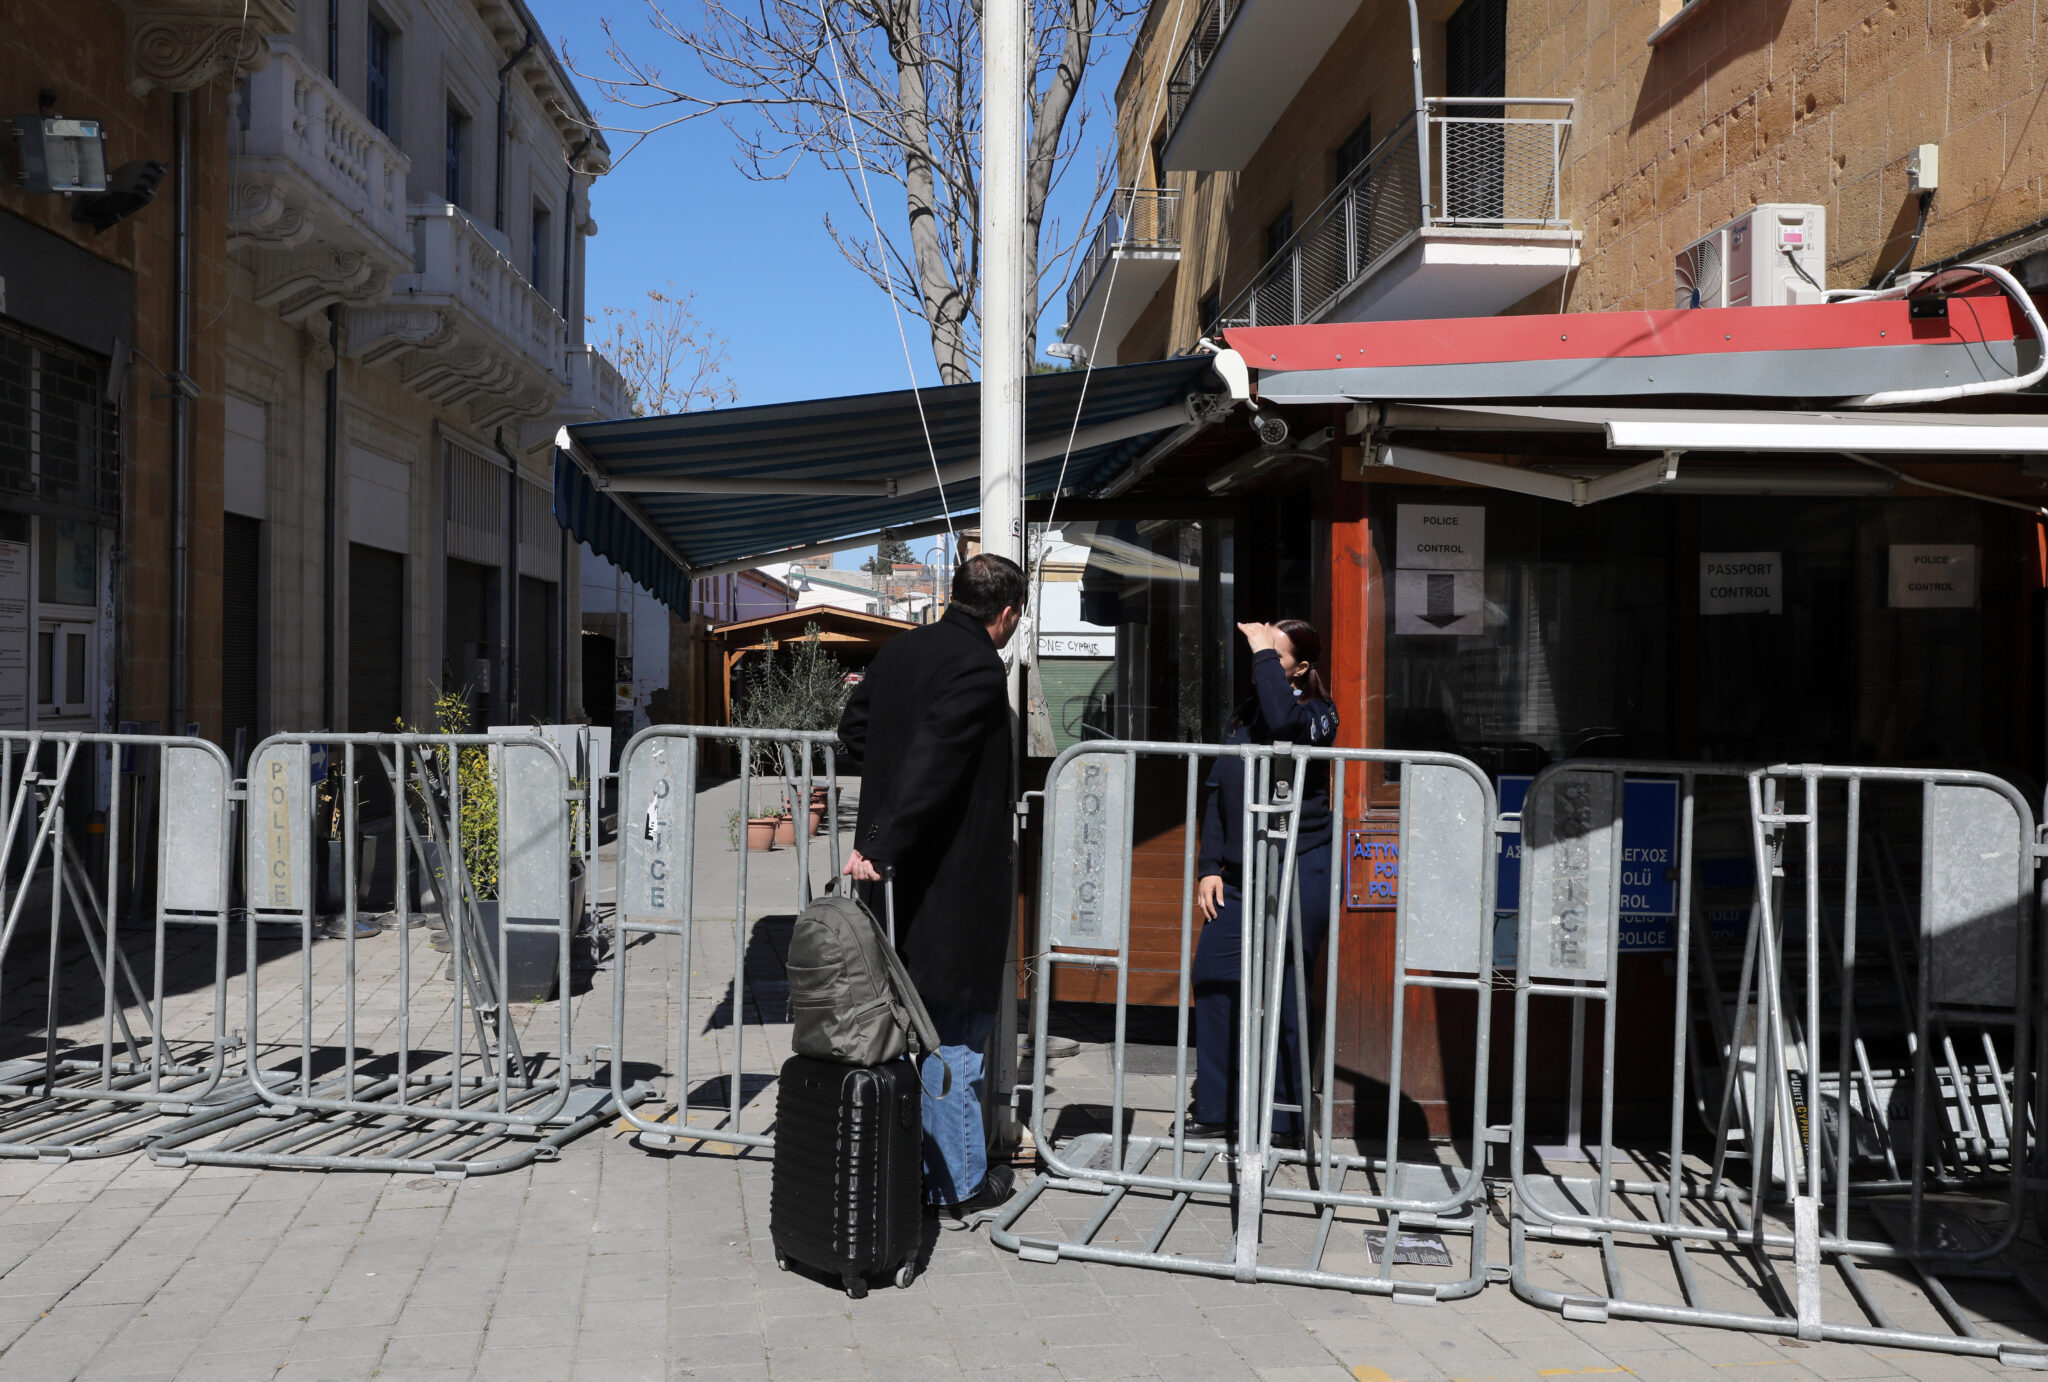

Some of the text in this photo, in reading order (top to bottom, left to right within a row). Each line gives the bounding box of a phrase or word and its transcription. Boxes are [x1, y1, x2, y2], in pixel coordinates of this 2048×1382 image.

[1423, 516, 1459, 525] POLICE
[1417, 544, 1464, 553] CONTROL
[1914, 555, 1949, 565] POLICE
[1708, 563, 1773, 575] PASSPORT
[1710, 586, 1772, 598] CONTROL
[1908, 582, 1955, 591] CONTROL
[1038, 638, 1100, 656] ONE CYPRUS
[270, 761, 287, 903] POLICE
[1077, 765, 1101, 932] POLICE
[1622, 848, 1668, 862] ΕΓΧΟΣ
[1375, 862, 1398, 876] POL
[1370, 881, 1398, 897] POL
[1621, 894, 1650, 908] ROL
